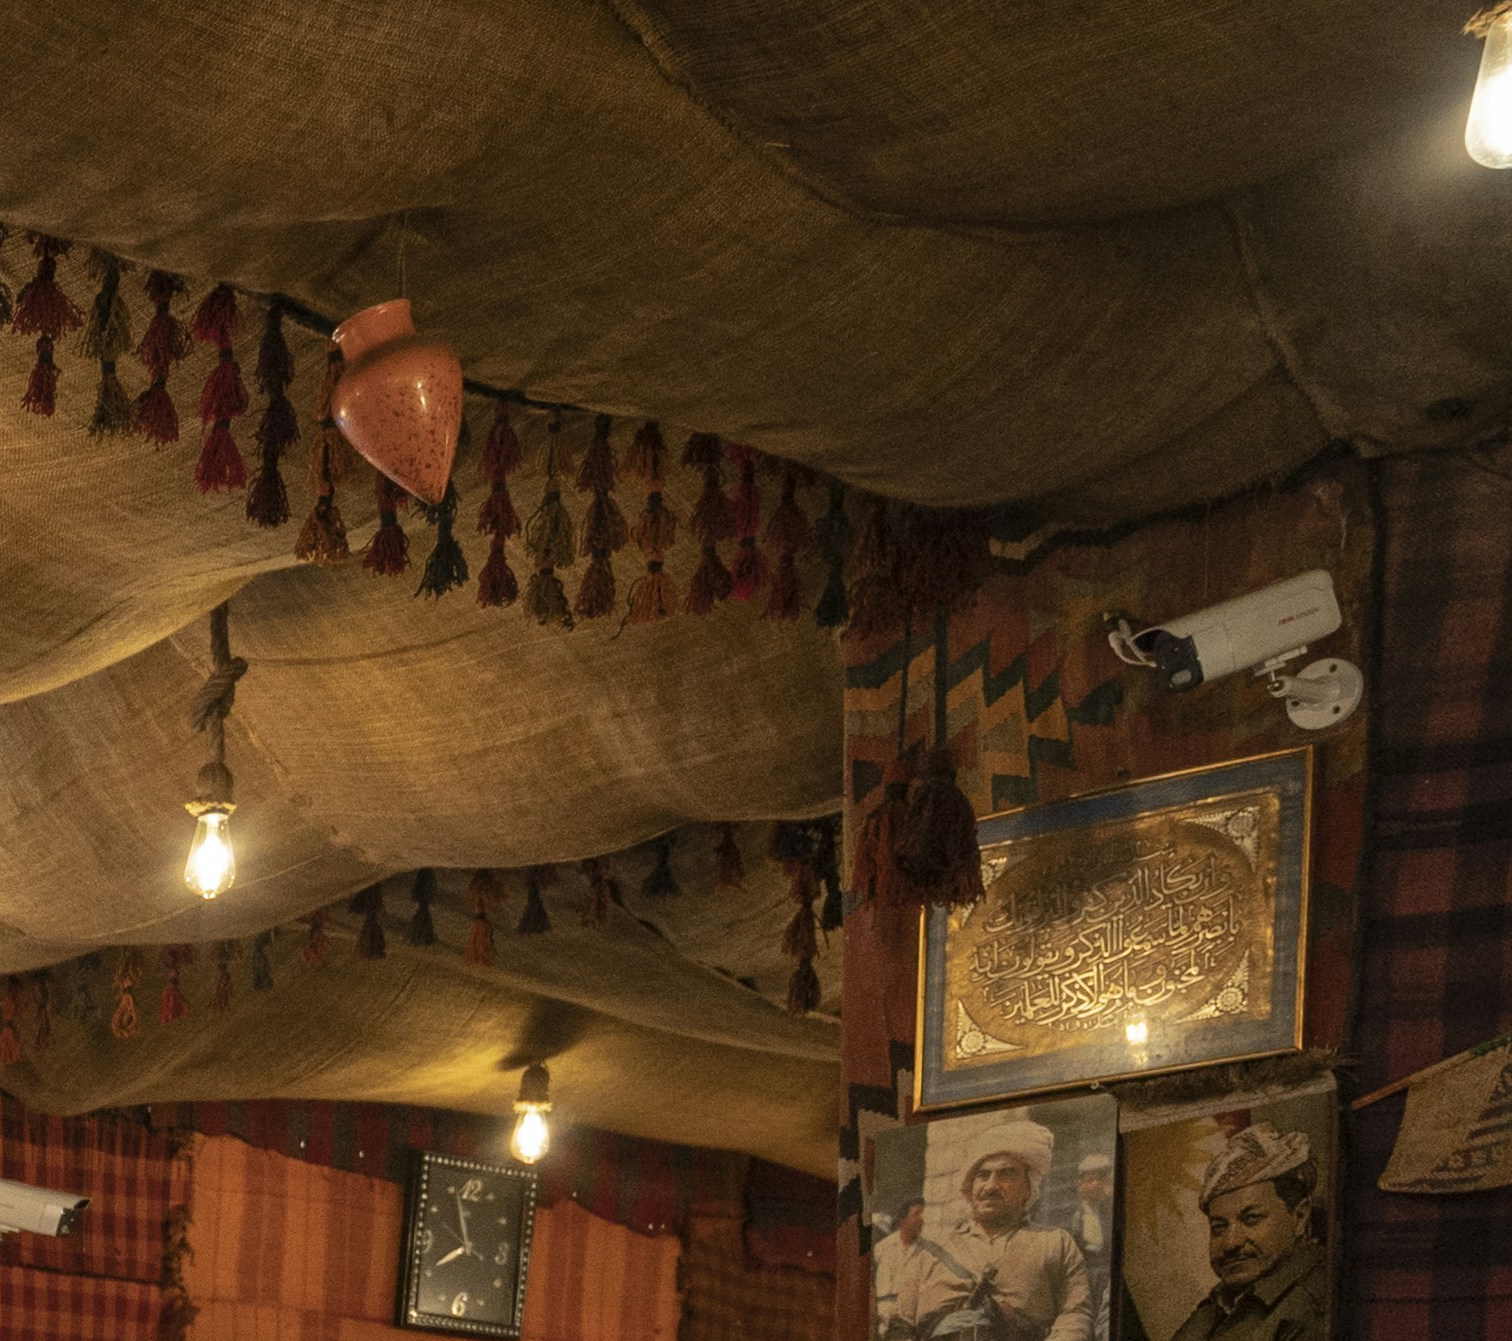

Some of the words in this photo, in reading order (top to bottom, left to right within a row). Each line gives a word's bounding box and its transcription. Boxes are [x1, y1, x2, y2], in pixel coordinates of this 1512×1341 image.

[461, 1178, 482, 1202] 12
[421, 1229, 434, 1255] 9
[494, 1242, 509, 1266] 3
[451, 1292, 468, 1316] 6
